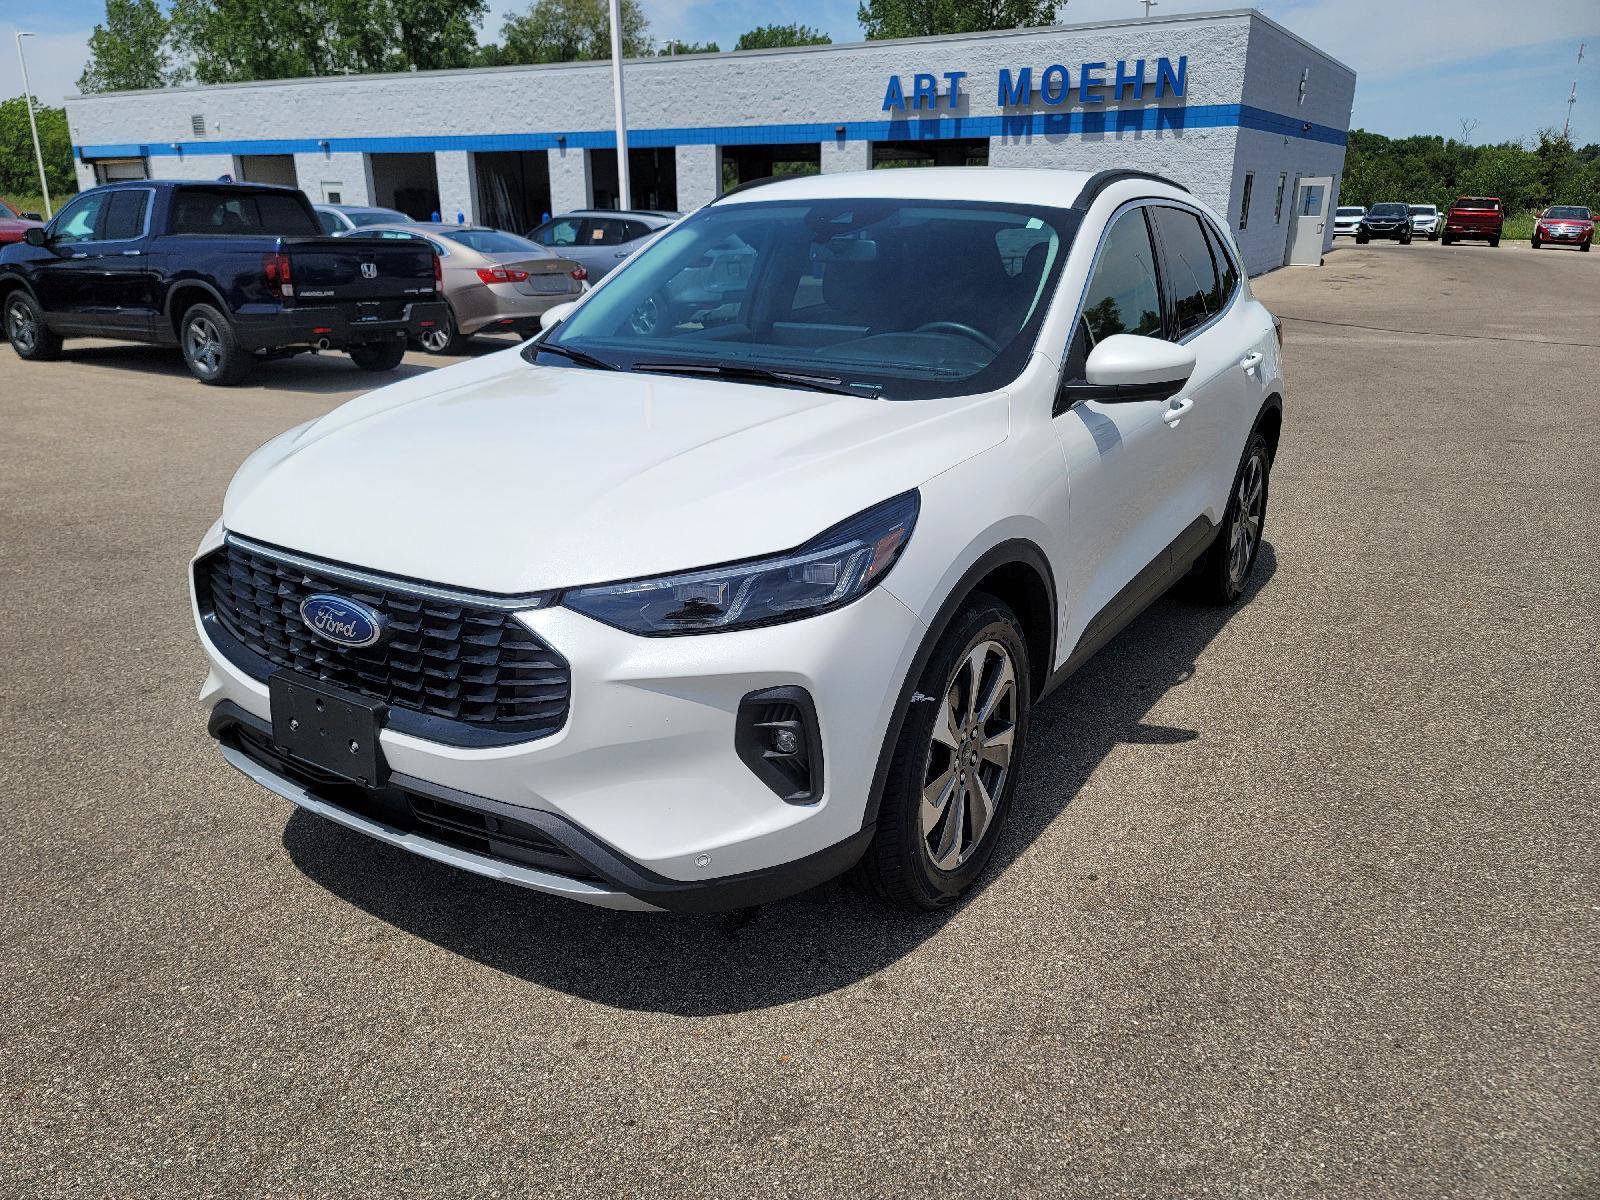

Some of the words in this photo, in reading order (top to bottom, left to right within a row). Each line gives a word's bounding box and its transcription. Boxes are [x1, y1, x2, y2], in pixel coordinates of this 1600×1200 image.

[882, 71, 968, 111] ART
[997, 55, 1188, 107] MOEHN
[314, 605, 357, 638] Ford
